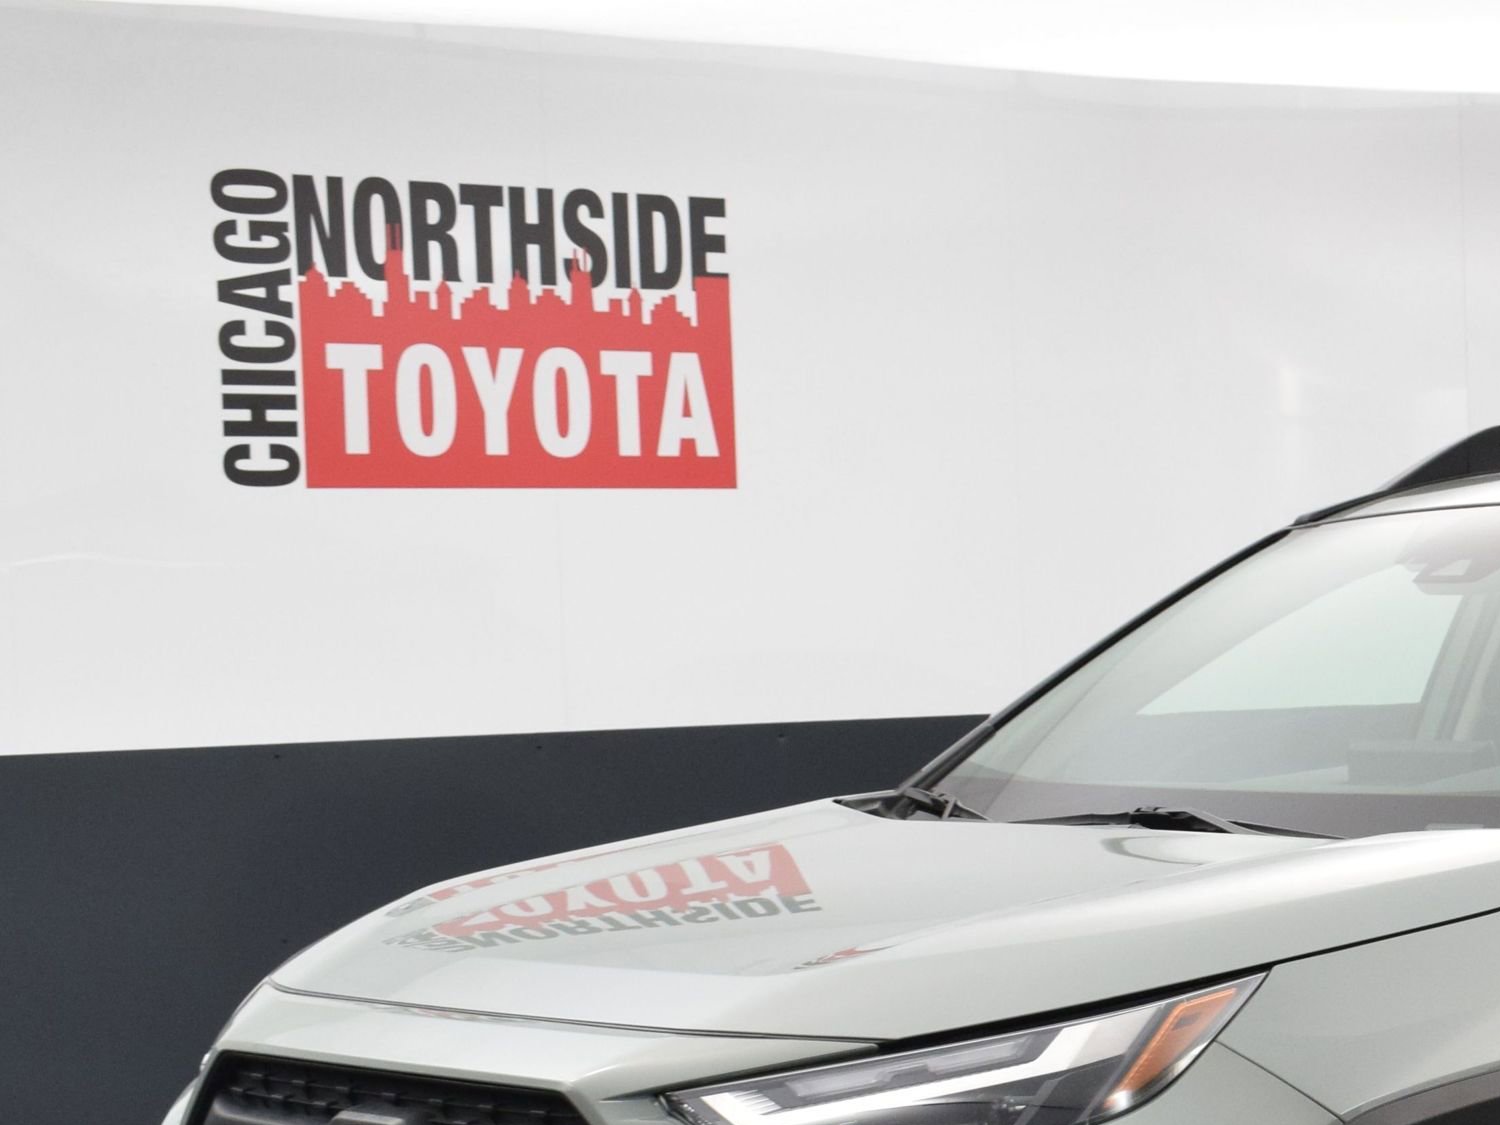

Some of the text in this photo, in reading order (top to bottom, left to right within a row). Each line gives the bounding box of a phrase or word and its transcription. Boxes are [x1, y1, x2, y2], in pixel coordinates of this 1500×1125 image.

[292, 174, 729, 291] NORTHSIDE
[210, 168, 300, 487] CHICAGO
[325, 343, 720, 458] TOYOTA
